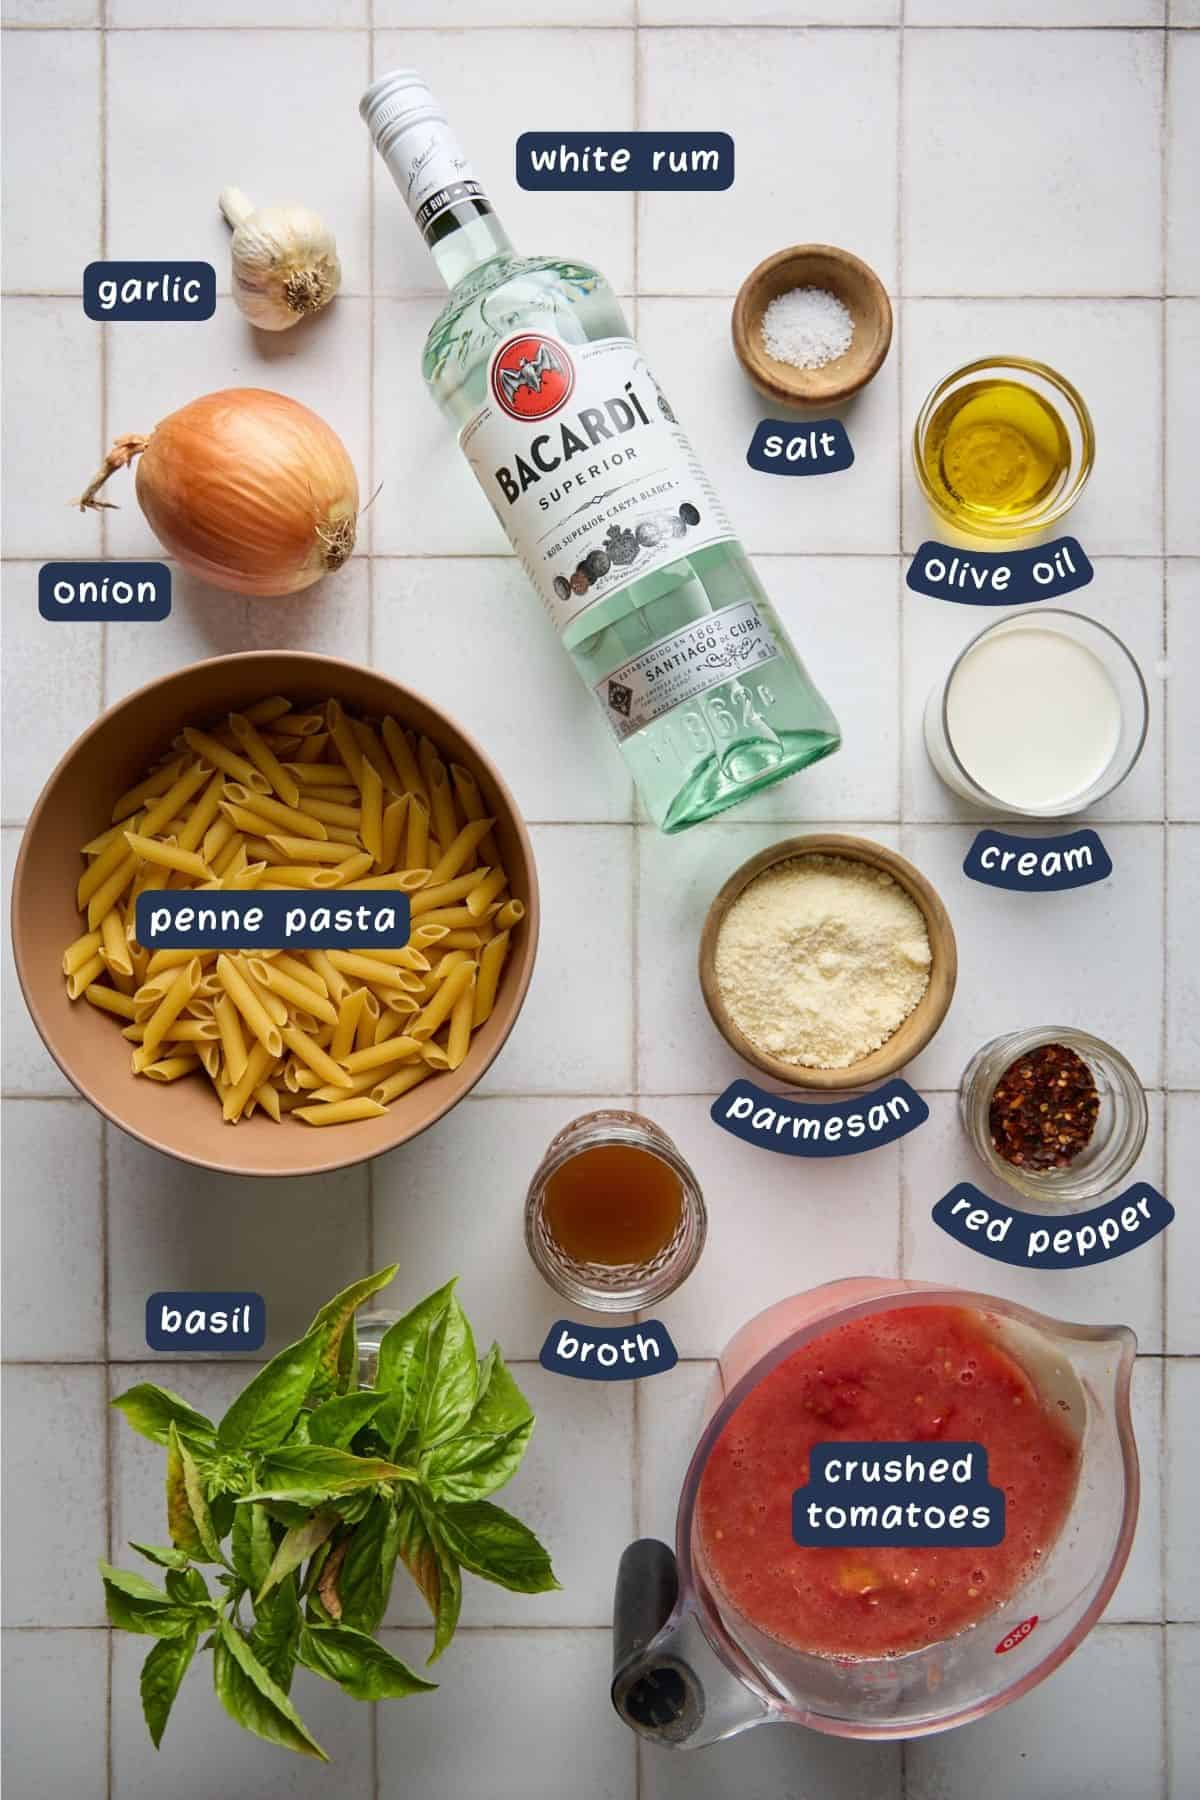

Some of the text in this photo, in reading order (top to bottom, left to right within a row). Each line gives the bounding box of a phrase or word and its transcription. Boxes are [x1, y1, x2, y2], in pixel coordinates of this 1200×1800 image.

[430, 191, 450, 211] RUM
[495, 381, 649, 505] BACARDÍ
[538, 447, 637, 511] SUPERIOR
[562, 514, 606, 547] SUPERIOR
[606, 497, 638, 518] CARTA
[619, 646, 672, 681] ESTABLECIDO
[689, 620, 723, 644] 1862
[645, 637, 717, 682] SANTIAGO
[729, 617, 762, 639] CUBA
[1003, 1623, 1031, 1648] OXO
